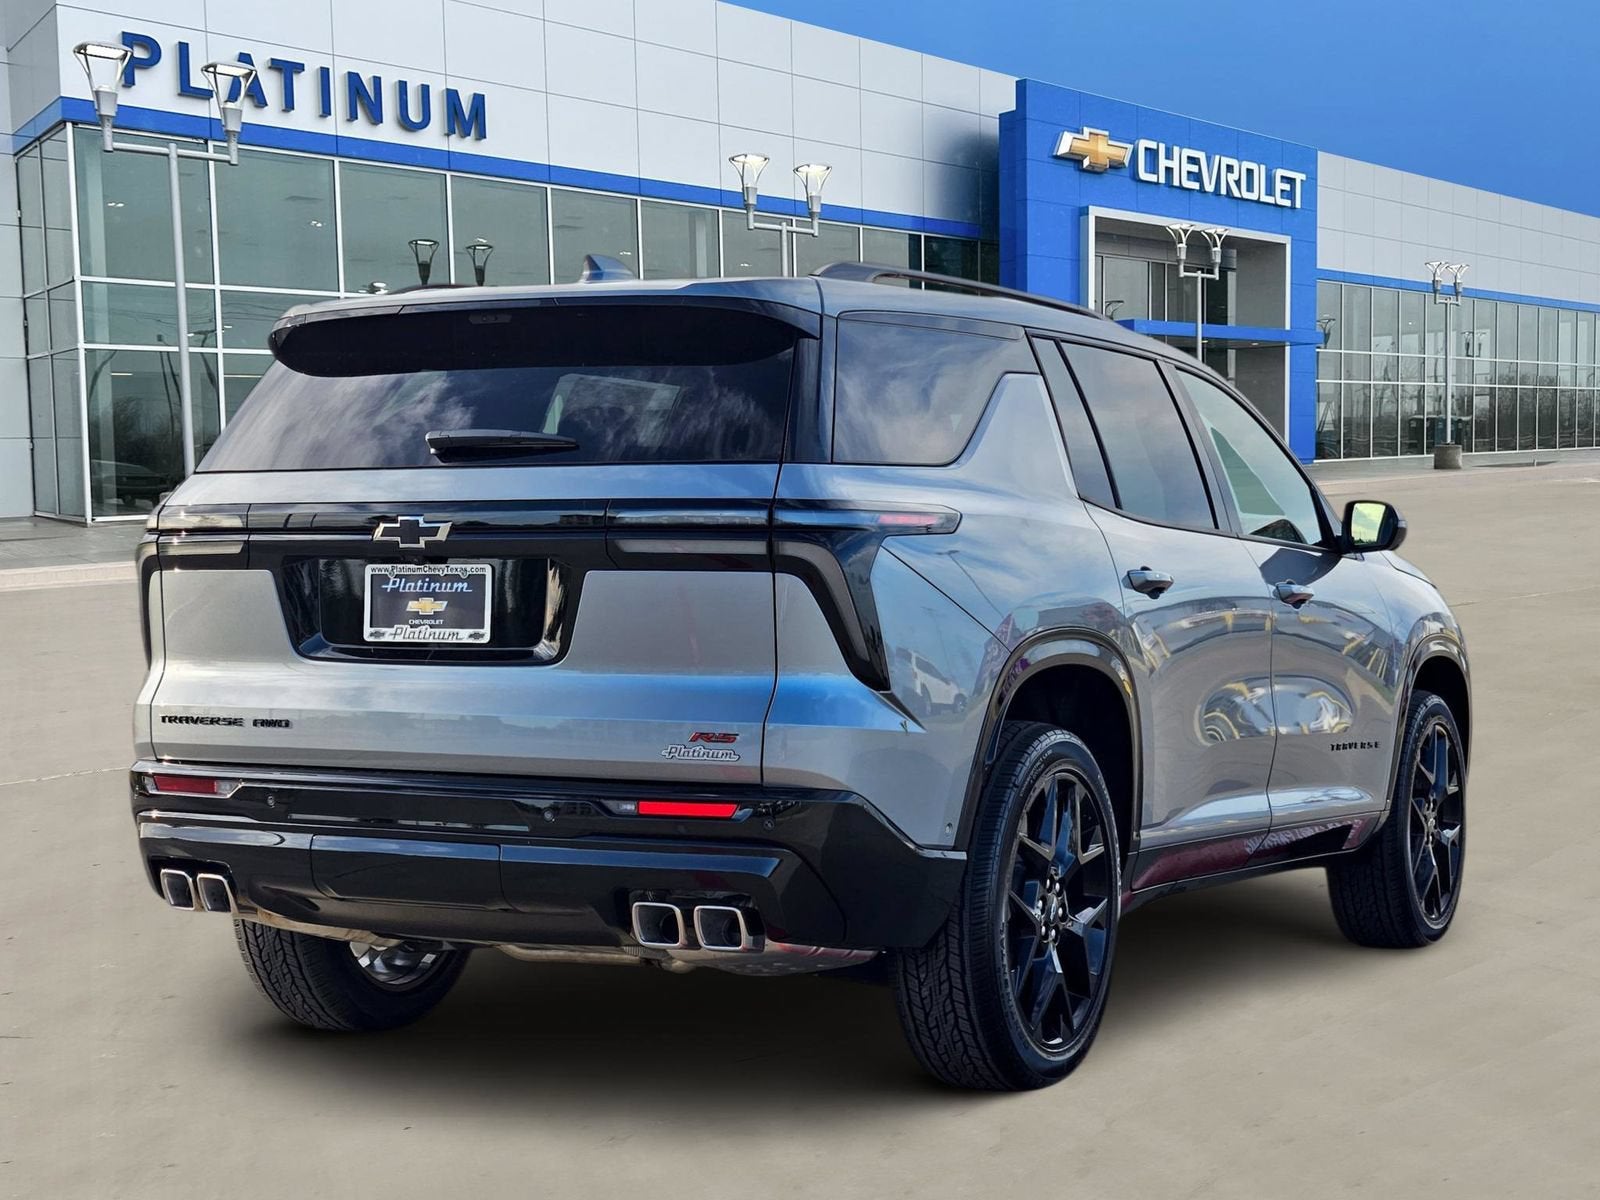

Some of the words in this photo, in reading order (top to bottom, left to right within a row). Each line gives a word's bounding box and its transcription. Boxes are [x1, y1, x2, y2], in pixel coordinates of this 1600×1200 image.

[121, 31, 487, 140] PLATINUM
[1136, 138, 1306, 209] CHEVROLET
[370, 565, 487, 575] www.PlatinumChevyTexas.com
[381, 577, 473, 592] Platinum
[389, 625, 464, 640] Platinum
[161, 715, 245, 727] TRAVERSE
[252, 718, 291, 728] AWD
[689, 732, 739, 743] RS
[661, 745, 741, 761] Platinum
[1330, 741, 1380, 751] TRAVERSE
